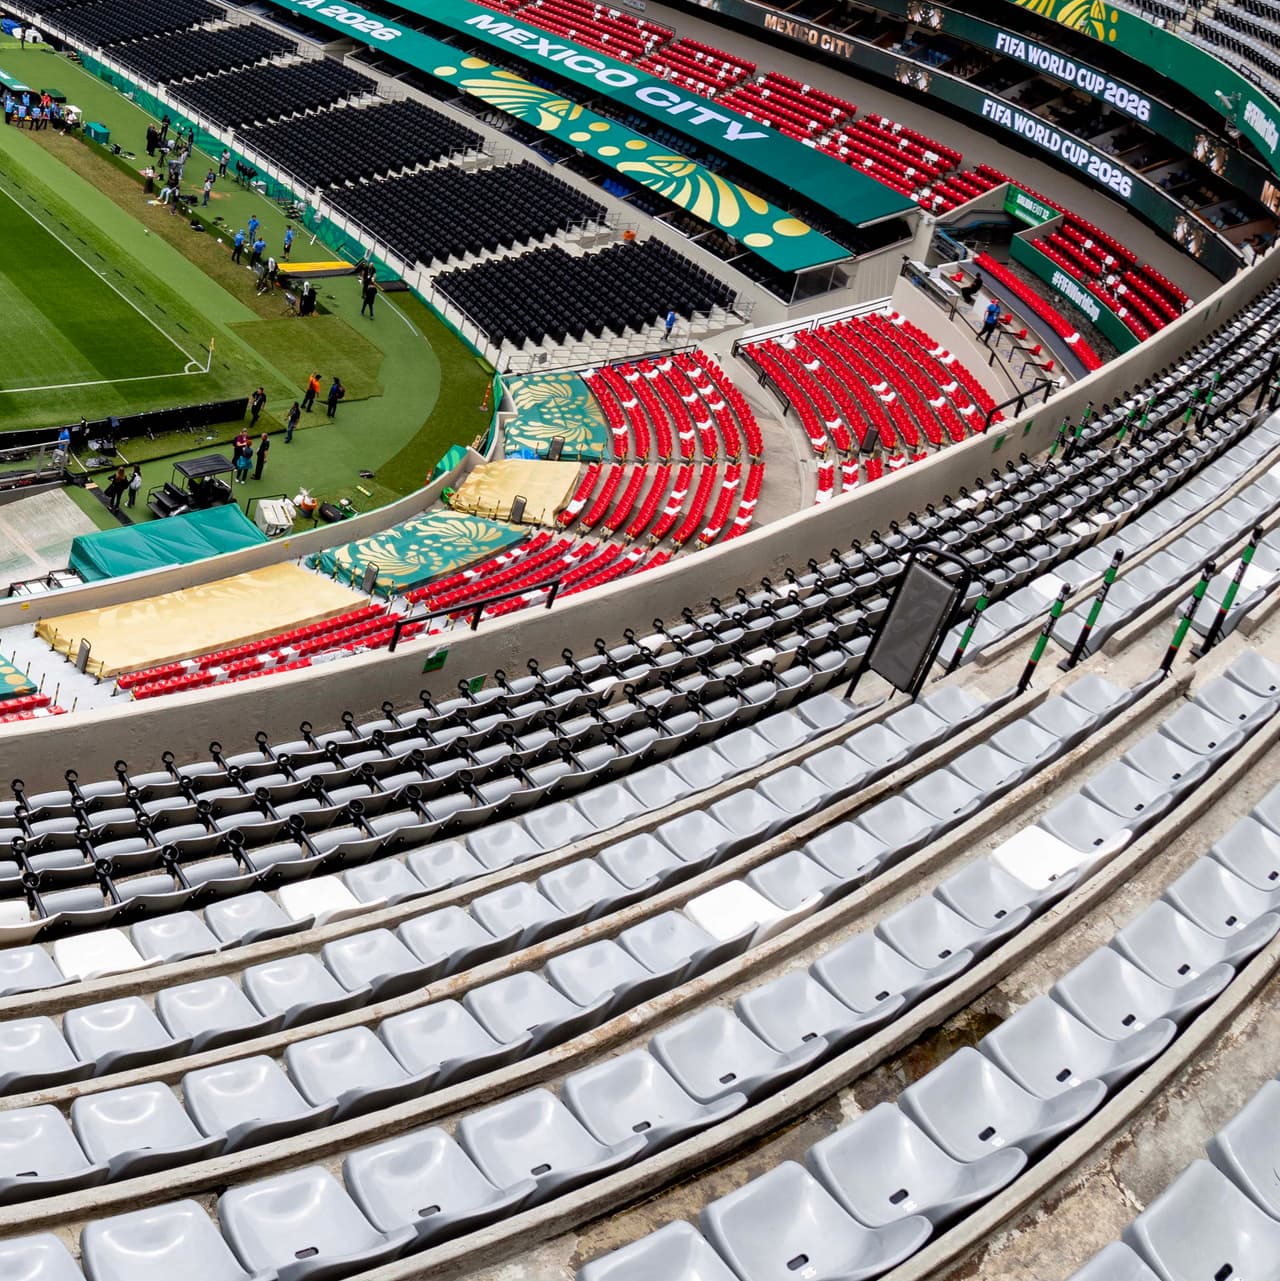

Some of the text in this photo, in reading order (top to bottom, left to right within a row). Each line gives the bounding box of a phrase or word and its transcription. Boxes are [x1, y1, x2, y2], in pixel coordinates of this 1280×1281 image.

[316, 4, 402, 41] 2026
[764, 14, 855, 59] MEXICO CITY
[464, 14, 769, 142] MEXICO CITY
[995, 32, 1150, 121] FIFA WORLD CUP 2026
[982, 98, 1132, 198] FIFA WORLD CUP 2026
